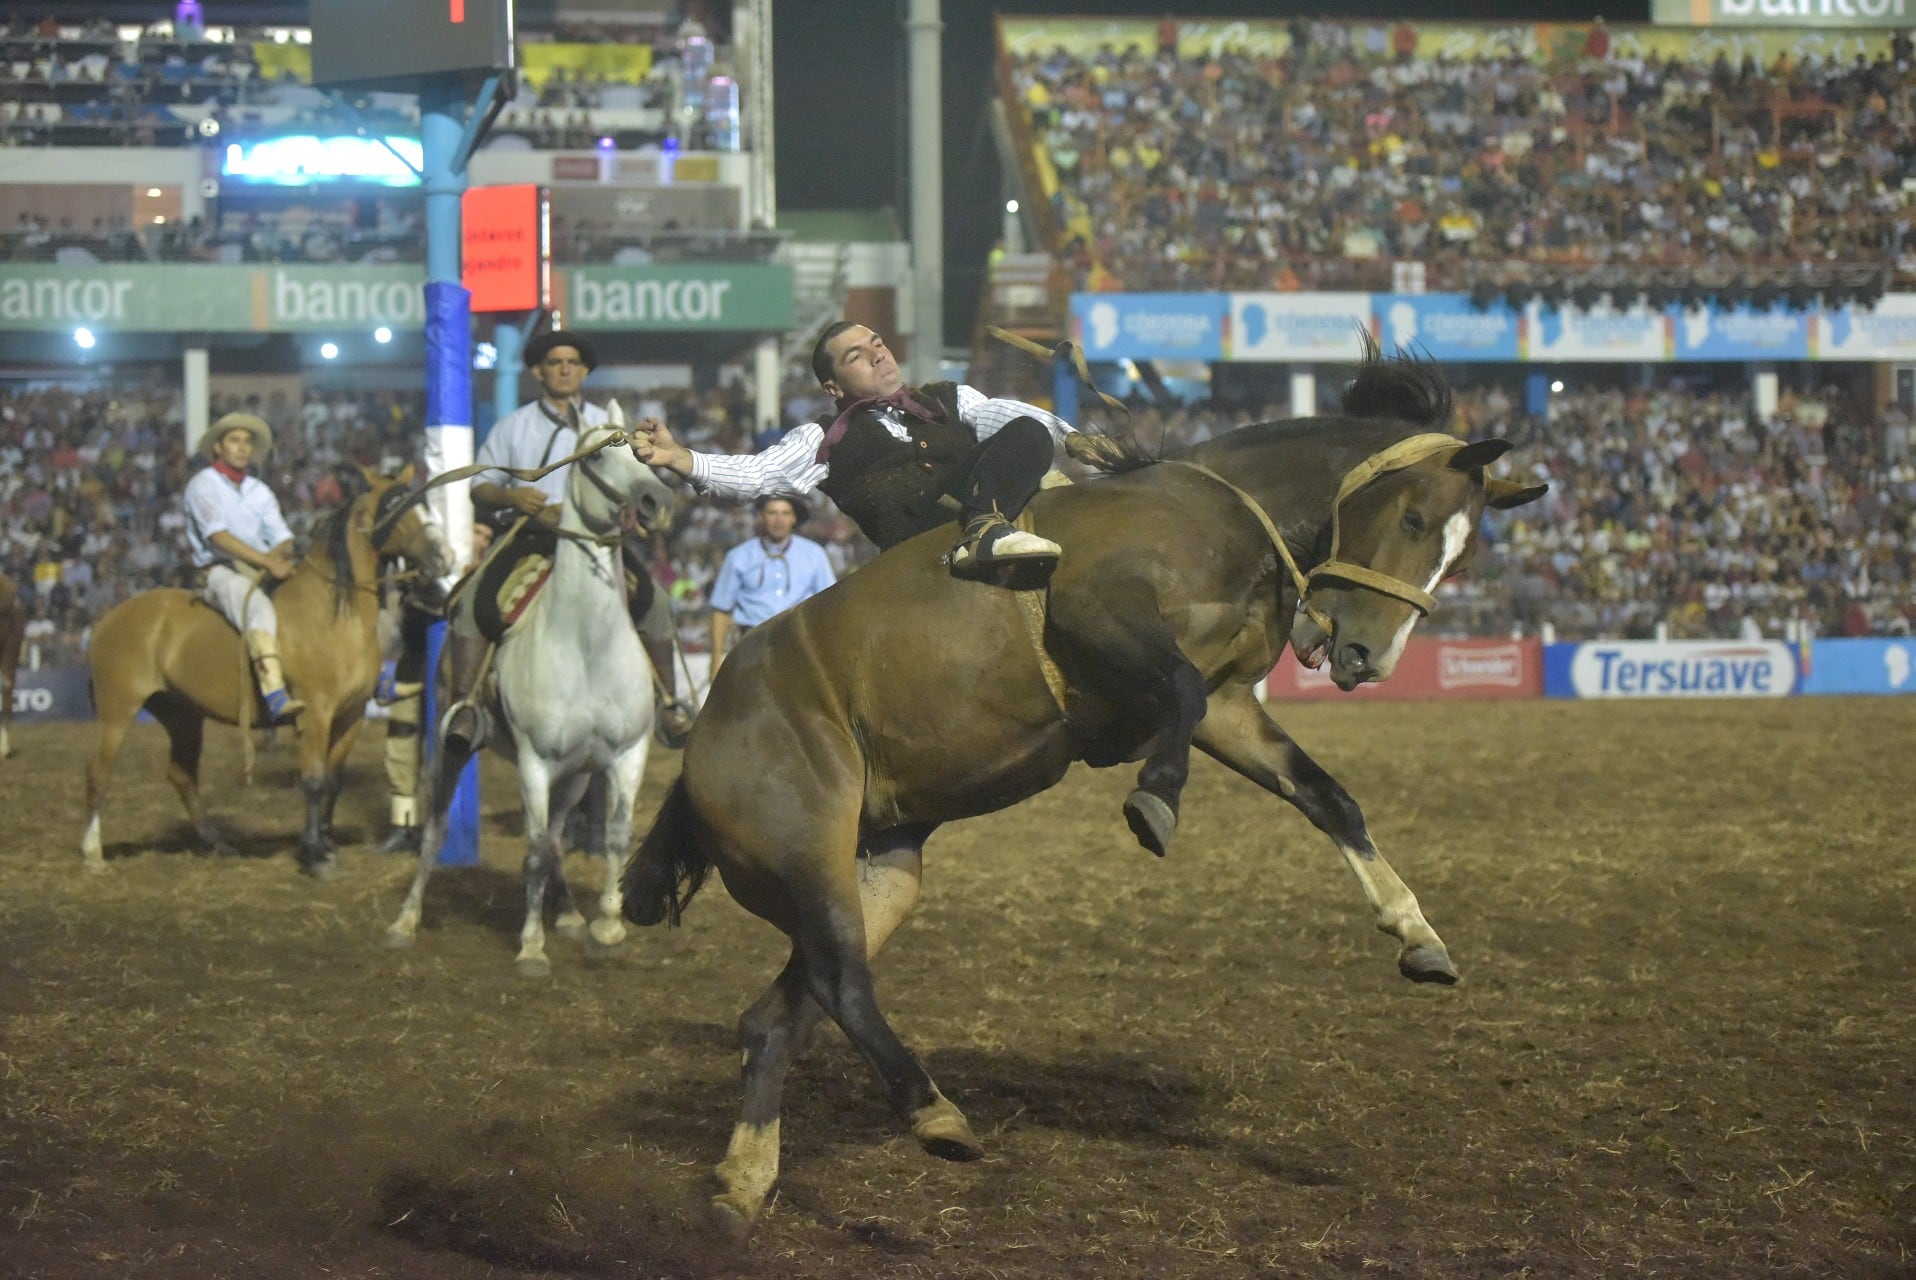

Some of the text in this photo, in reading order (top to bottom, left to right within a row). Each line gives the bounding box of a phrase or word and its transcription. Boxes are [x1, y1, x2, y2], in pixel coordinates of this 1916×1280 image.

[2, 278, 133, 318] ancor
[573, 271, 731, 320] bancor
[1594, 650, 1772, 692] Tersuave
